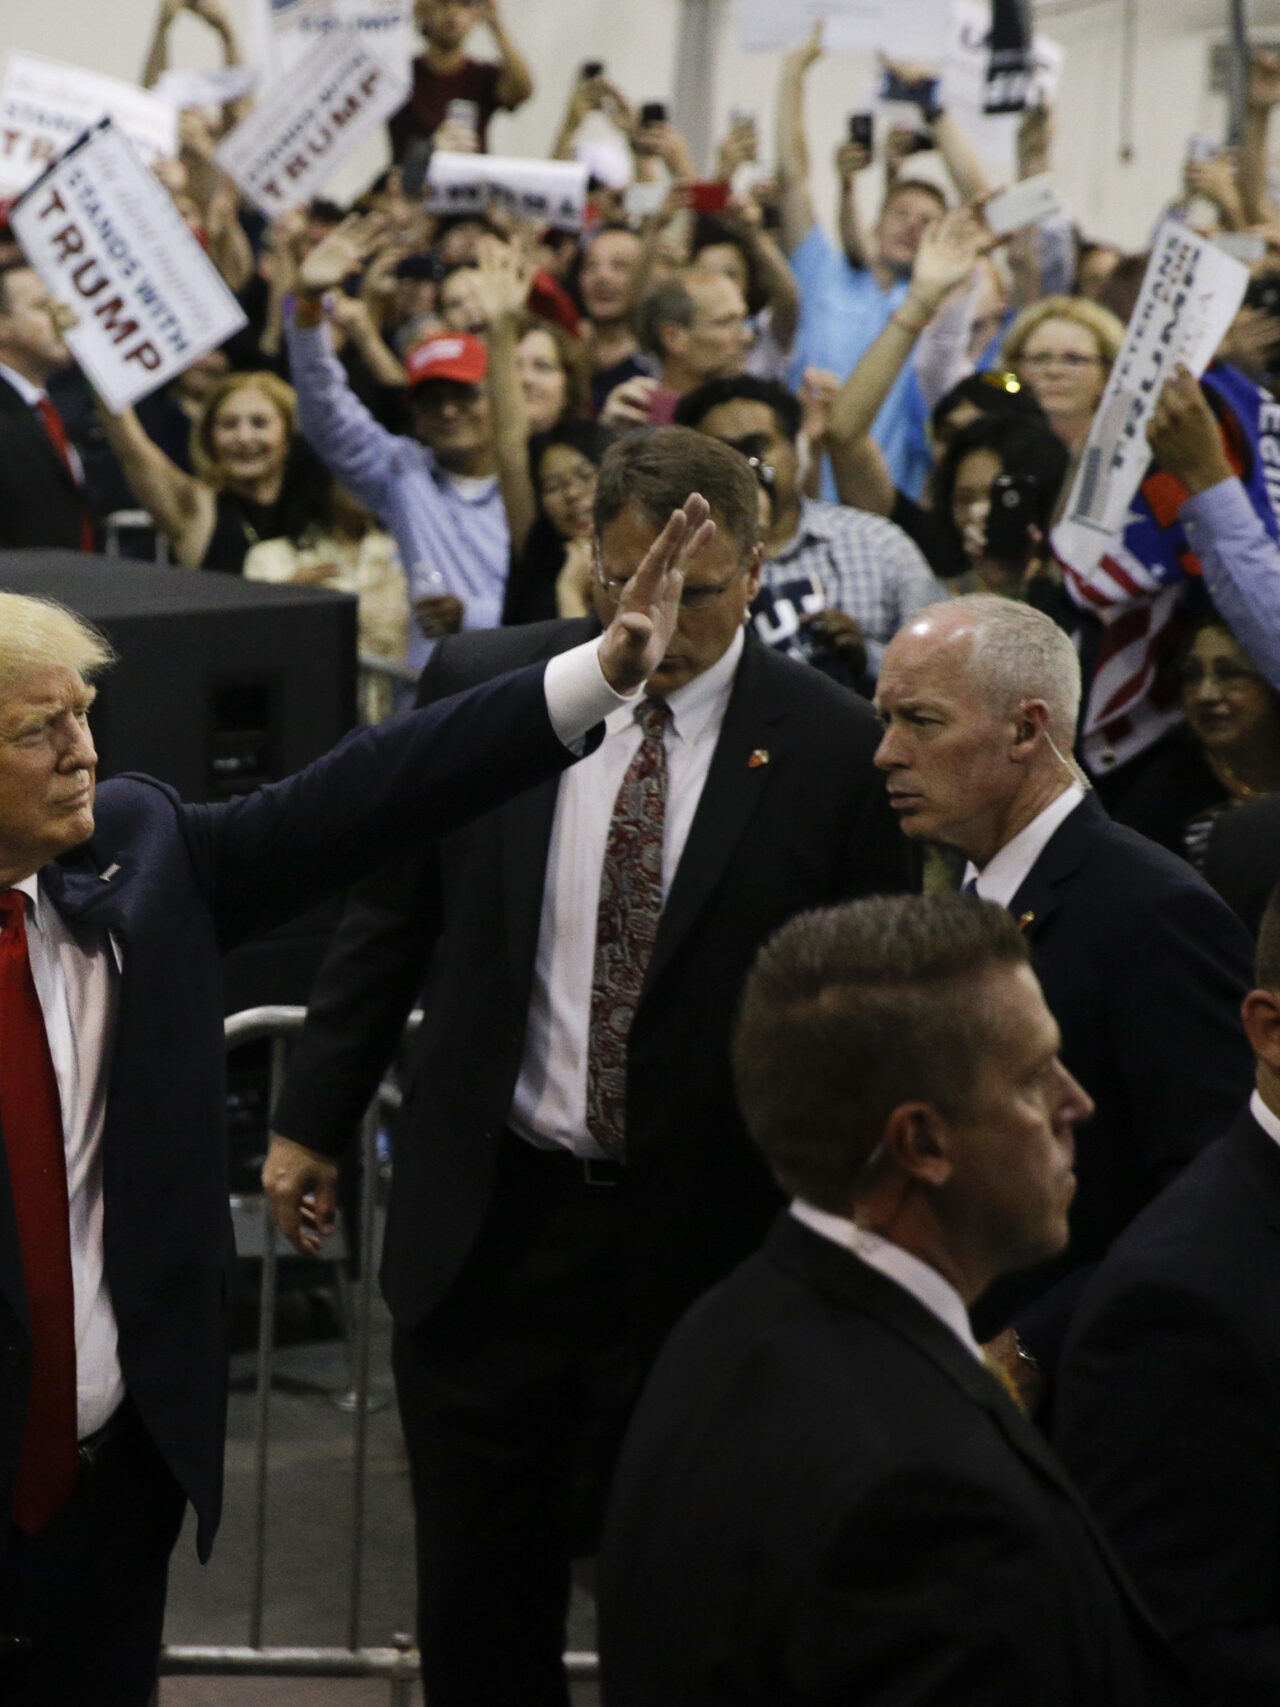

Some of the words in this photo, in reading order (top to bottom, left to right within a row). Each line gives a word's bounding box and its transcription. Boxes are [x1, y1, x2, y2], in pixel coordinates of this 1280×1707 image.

[262, 66, 380, 199] TRUMP
[38, 189, 162, 372] TRUMP
[67, 169, 140, 277] STANDS
[134, 276, 190, 353] WITH
[1112, 235, 1181, 397] VETERANS
[1110, 248, 1203, 470] TRUMP
